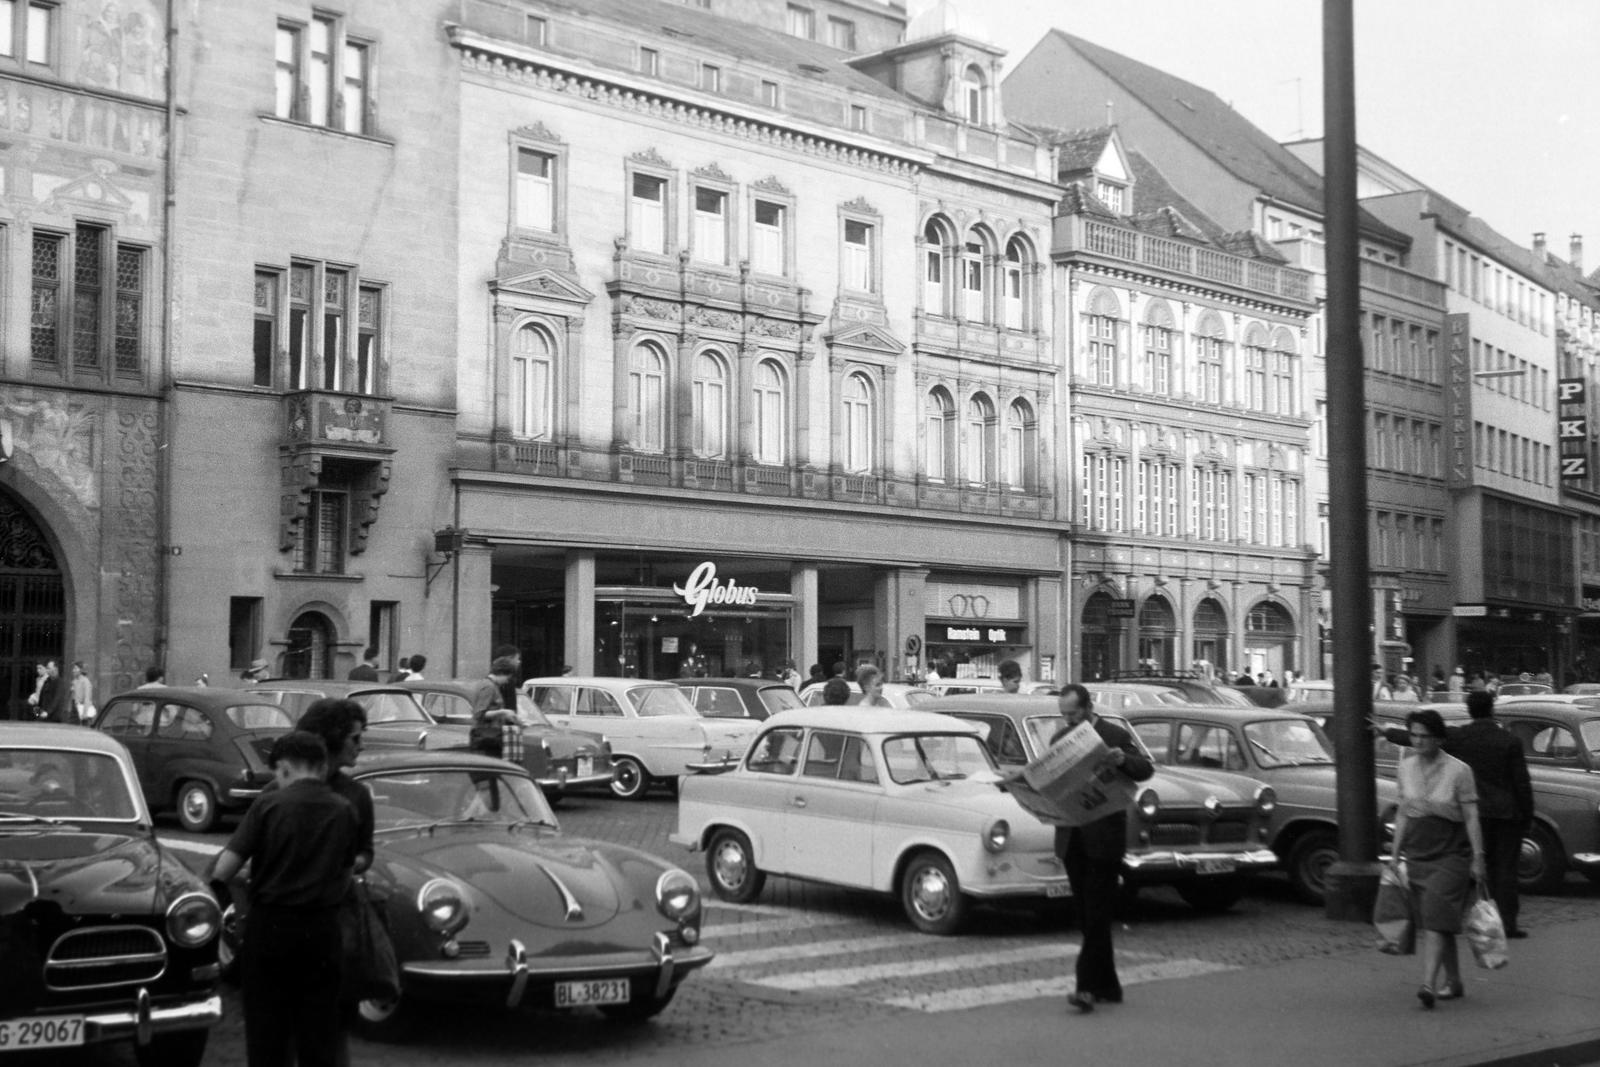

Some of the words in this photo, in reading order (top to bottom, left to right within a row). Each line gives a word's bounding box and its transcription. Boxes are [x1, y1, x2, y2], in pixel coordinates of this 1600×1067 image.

[1451, 320, 1467, 480] BANKVEREIN
[1558, 382, 1586, 477] PKZ
[673, 561, 759, 617] Globus
